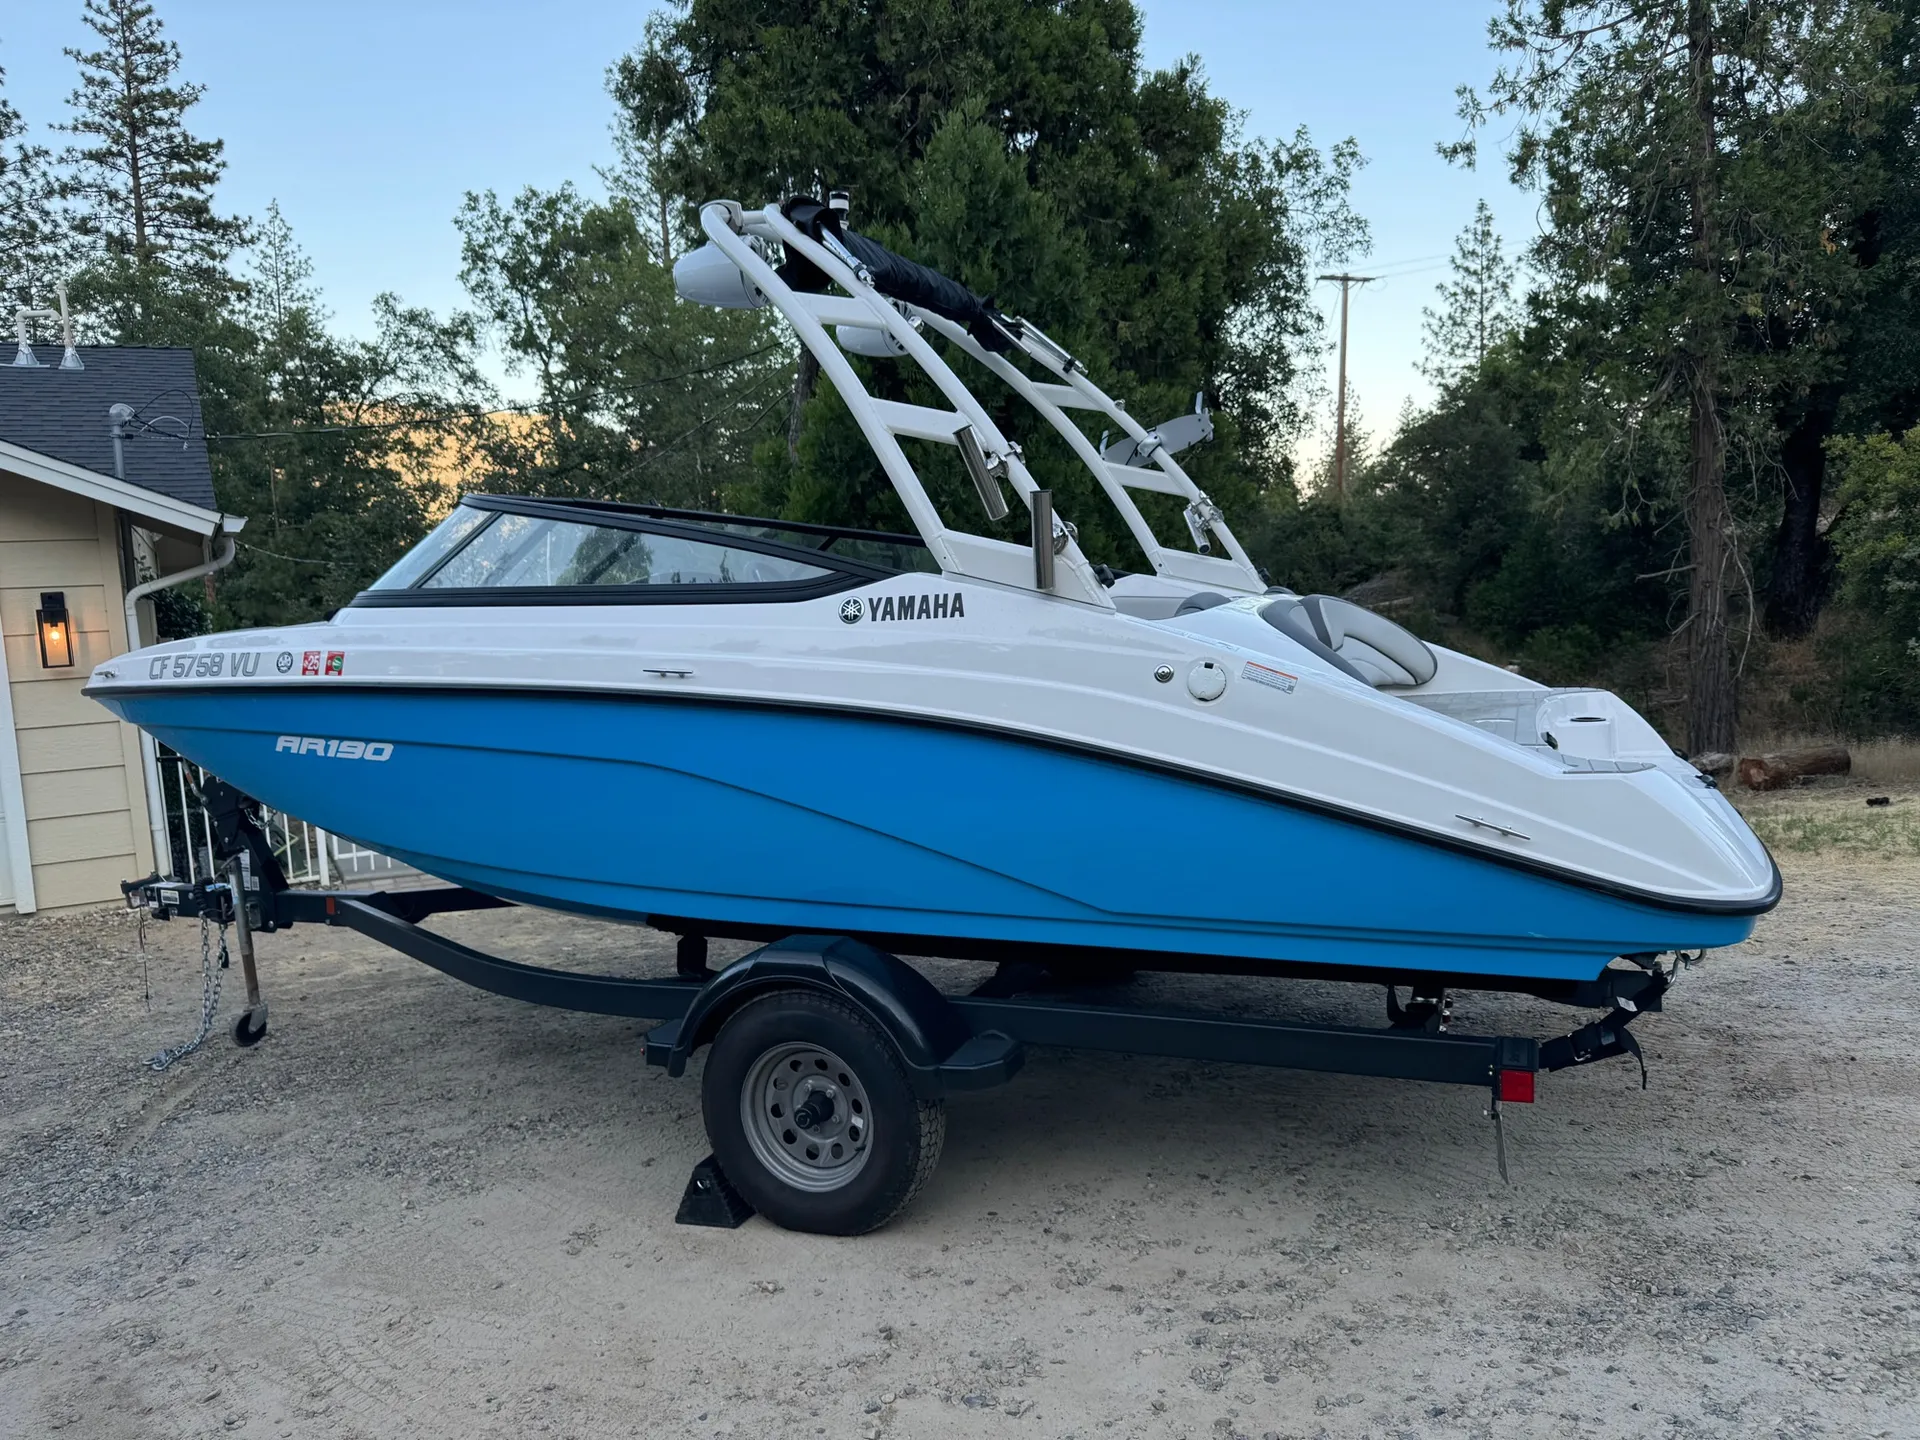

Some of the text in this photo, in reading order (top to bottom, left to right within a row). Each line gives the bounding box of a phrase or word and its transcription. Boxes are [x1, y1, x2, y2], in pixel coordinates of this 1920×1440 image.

[869, 593, 965, 622] YAMAHA
[149, 653, 260, 680] CF 5758 VU
[308, 655, 320, 671] 25
[275, 735, 394, 761] AR190
